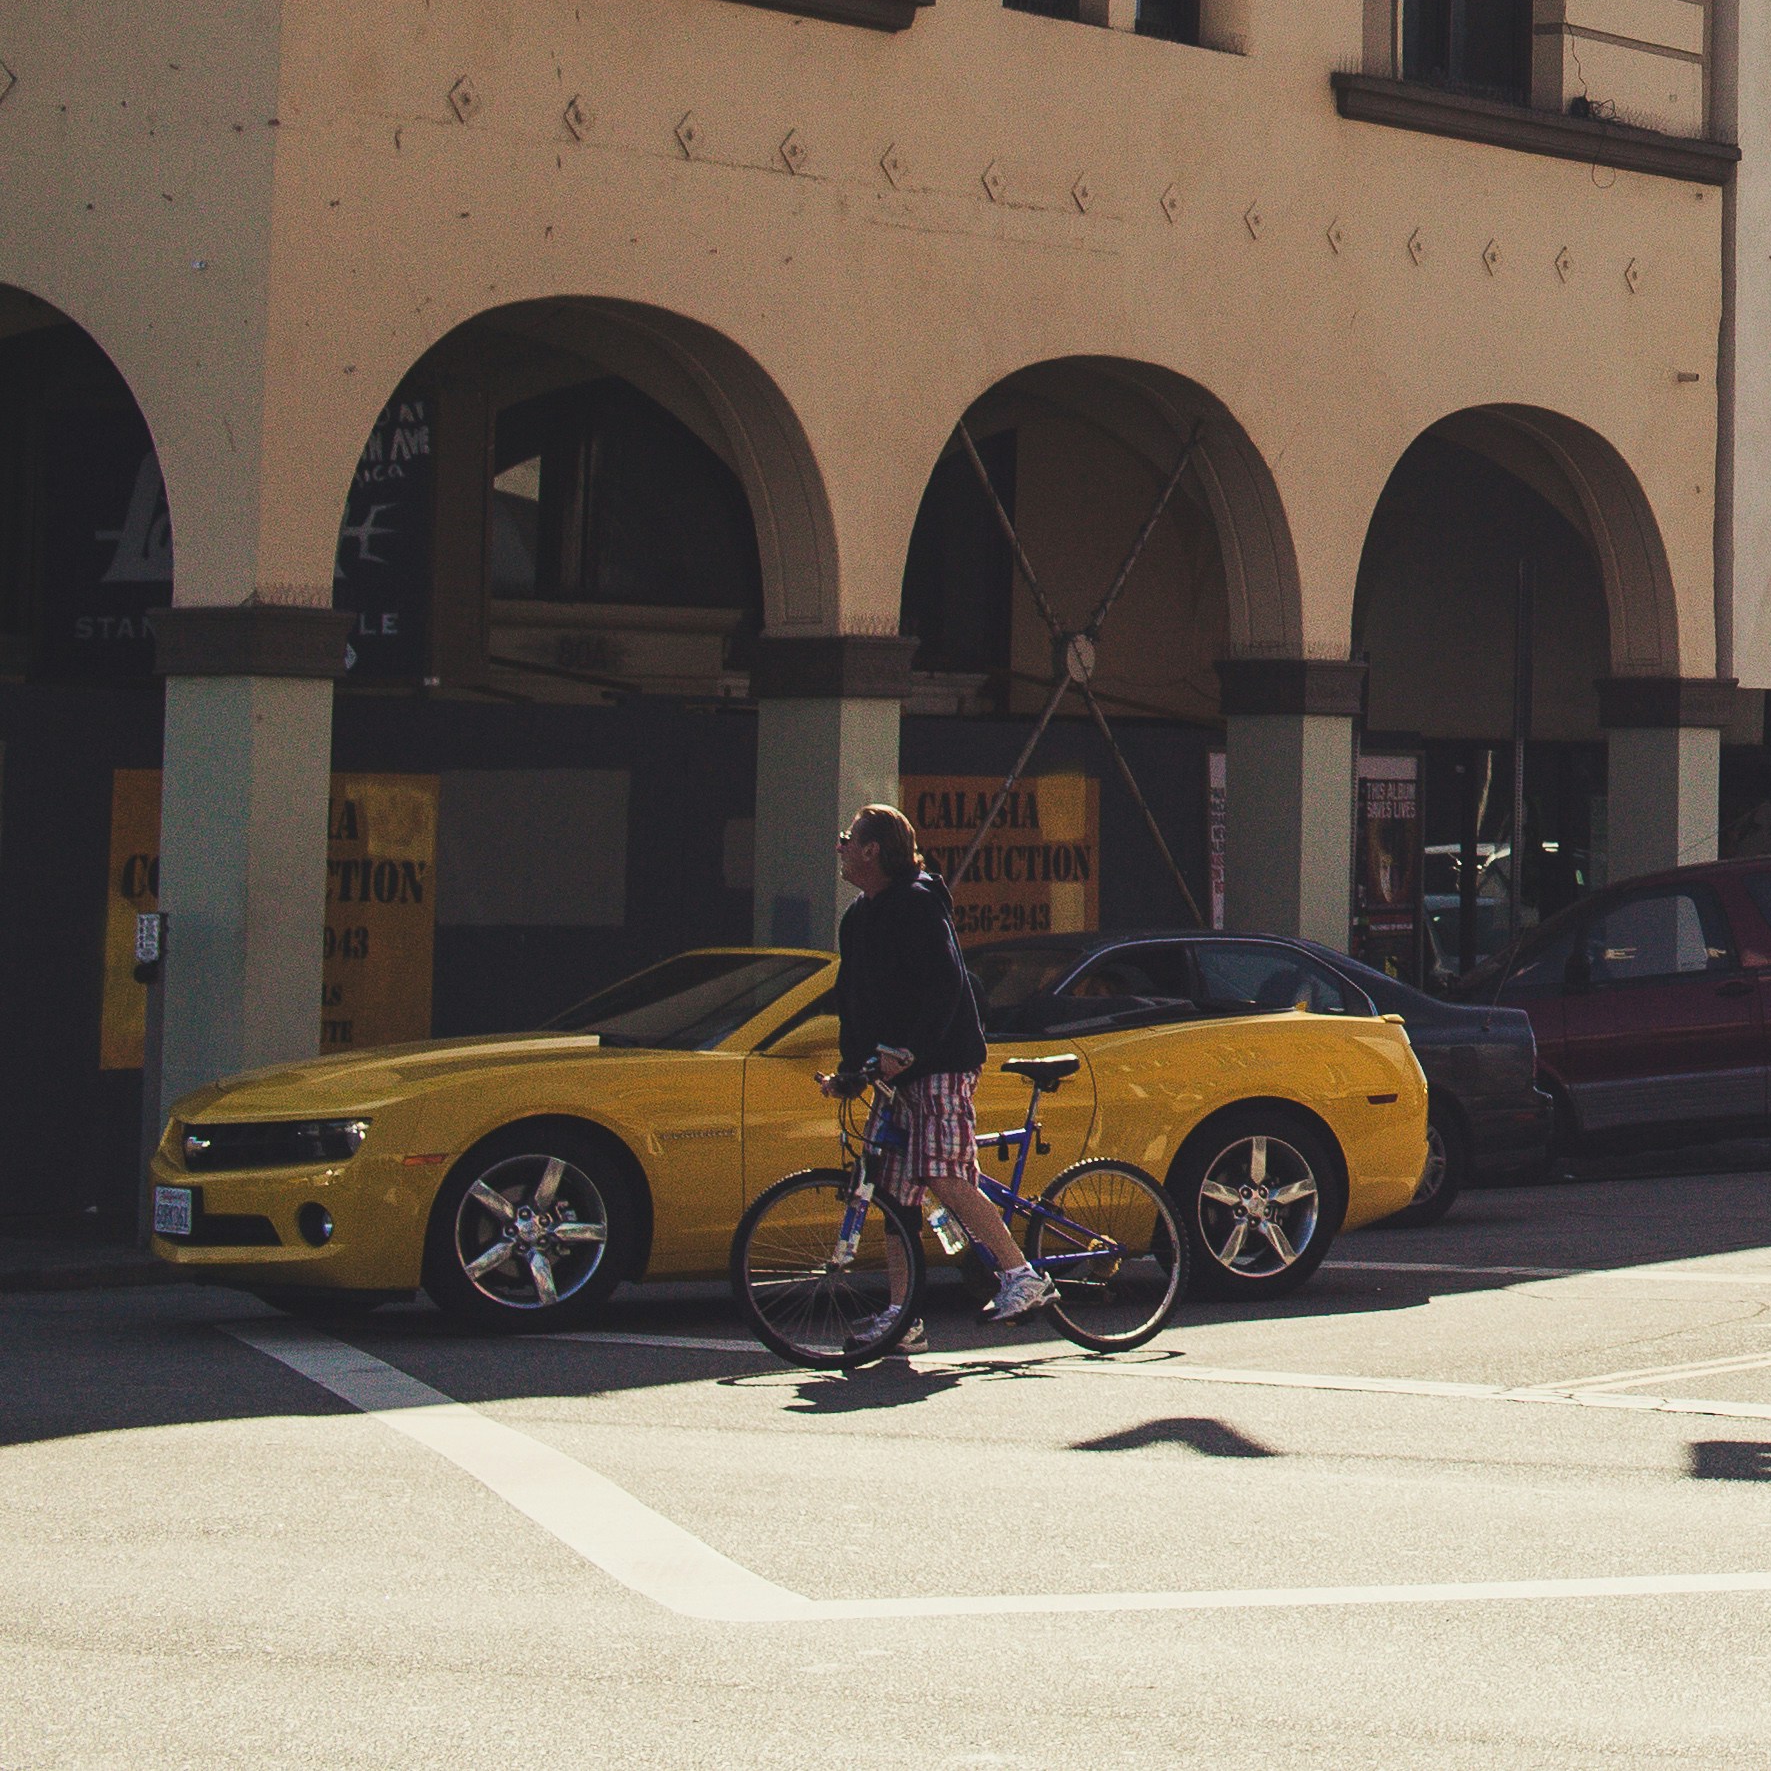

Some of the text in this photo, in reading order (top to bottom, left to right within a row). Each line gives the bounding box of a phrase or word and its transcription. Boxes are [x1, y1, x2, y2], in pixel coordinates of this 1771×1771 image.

[1366, 782, 1386, 800] THIS
[917, 792, 1039, 828] CALASIA
[922, 844, 1091, 882] STRUCTION
